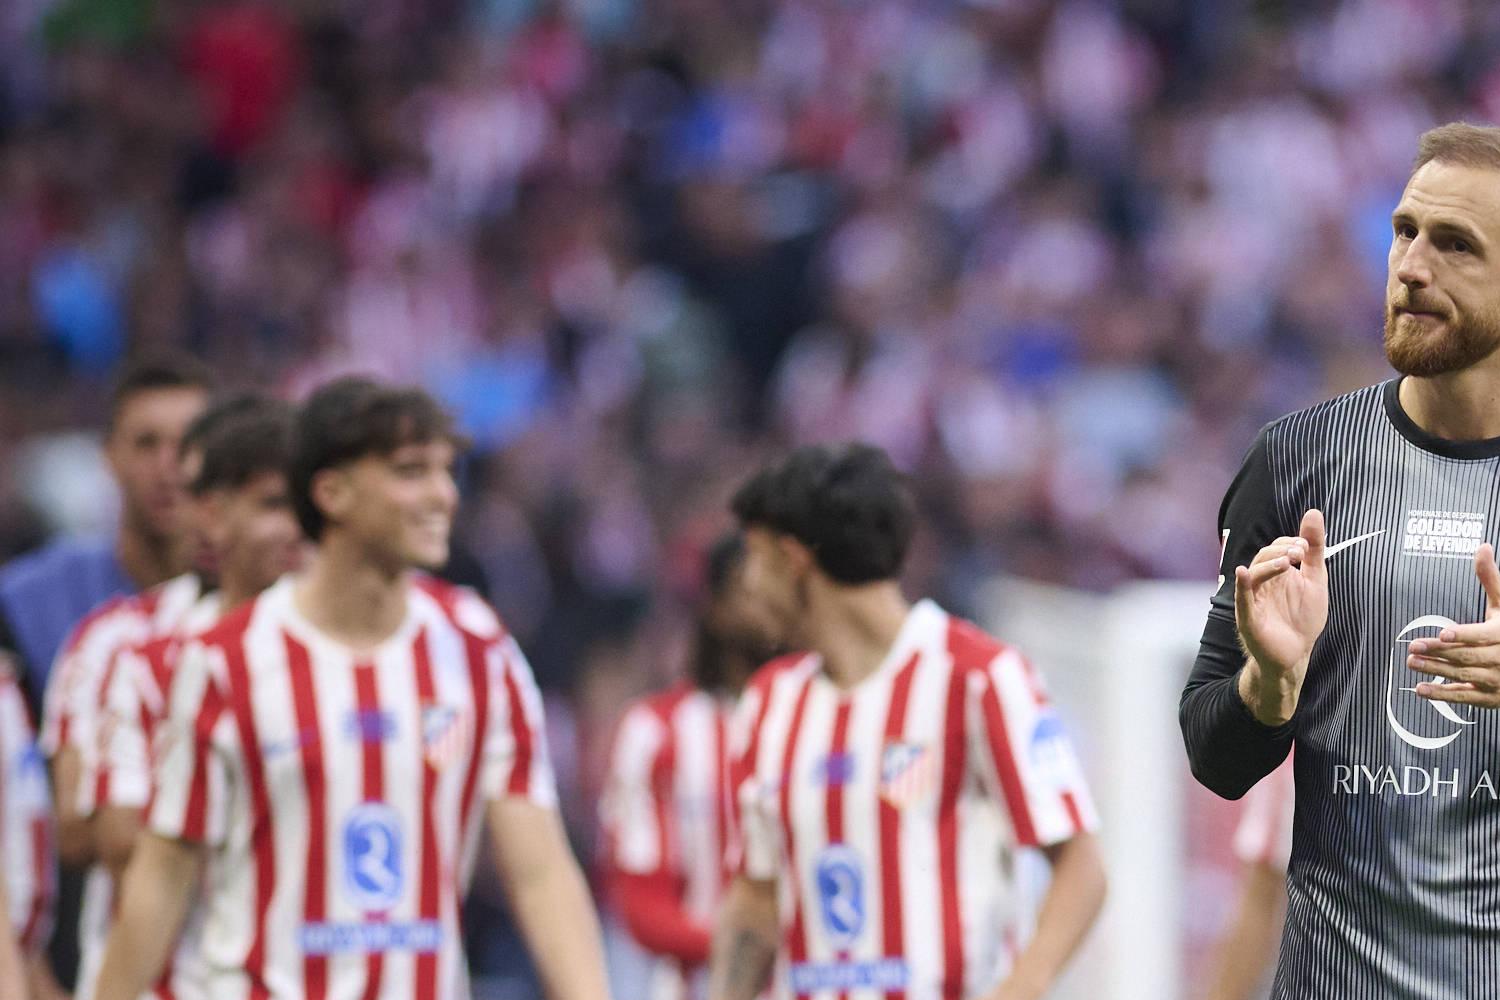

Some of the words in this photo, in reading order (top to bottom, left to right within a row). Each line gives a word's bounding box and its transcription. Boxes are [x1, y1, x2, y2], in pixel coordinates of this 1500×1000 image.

[1407, 518, 1482, 538] GOLEADOR
[1403, 534, 1422, 550] DE
[1332, 764, 1459, 798] RIYADH
